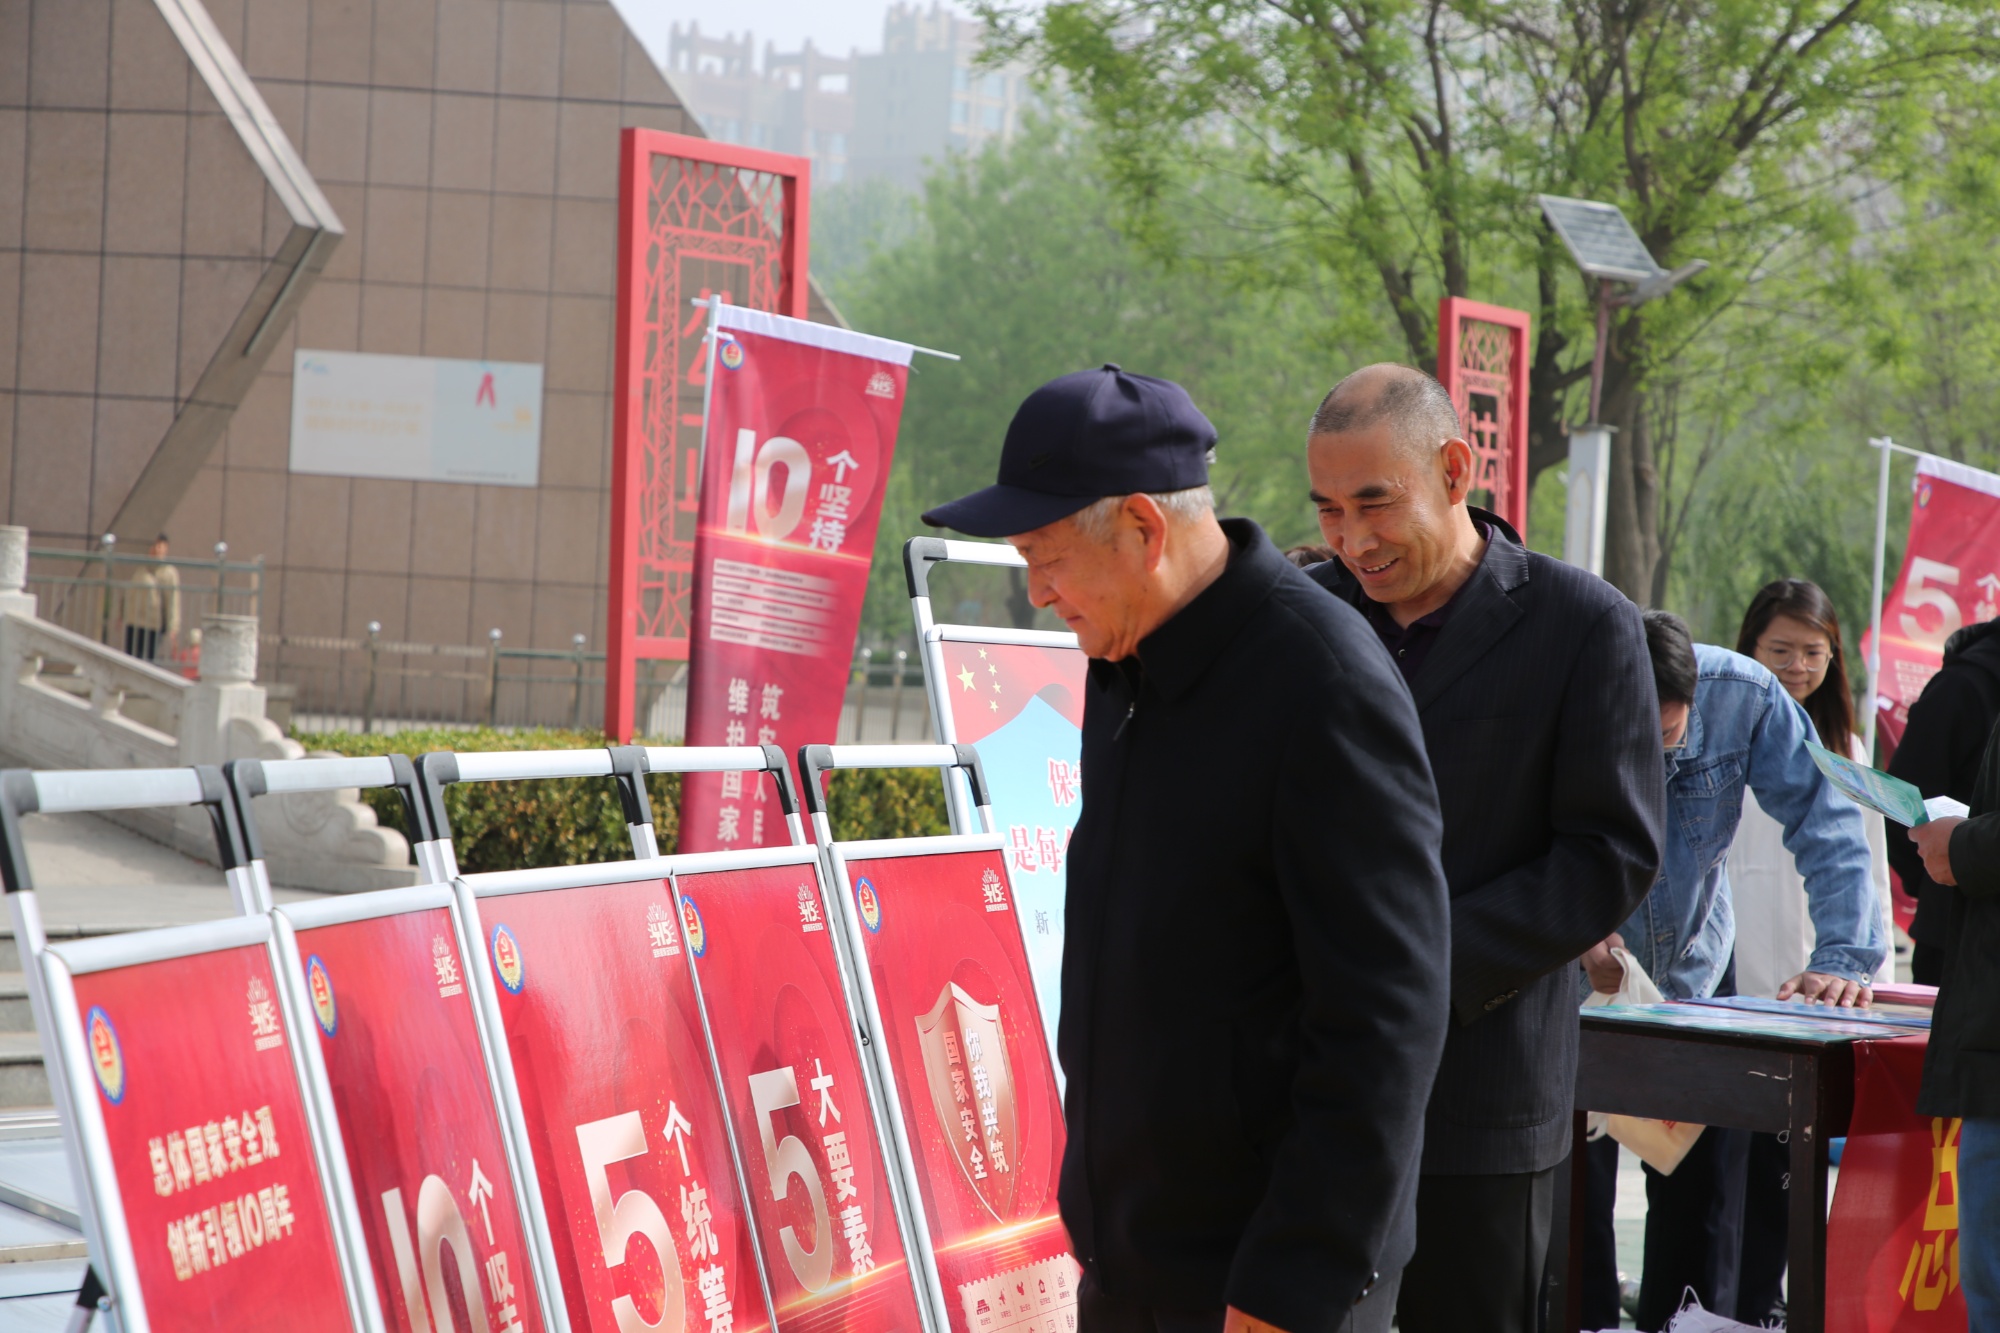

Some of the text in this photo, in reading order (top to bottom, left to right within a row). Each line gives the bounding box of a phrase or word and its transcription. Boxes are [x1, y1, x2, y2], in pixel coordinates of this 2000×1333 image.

[726, 428, 860, 554] 10 个坚持
[1899, 556, 1963, 653] 5
[148, 1105, 280, 1198] 总体国家安全观
[942, 1030, 988, 1181] 国家安全
[964, 1027, 1010, 1174] 你我共筑
[167, 1182, 295, 1281] 创新引领10周年
[575, 1100, 734, 1333] 5 个统筹
[748, 1058, 875, 1293] 5 大要素
[381, 1173, 490, 1333] 10
